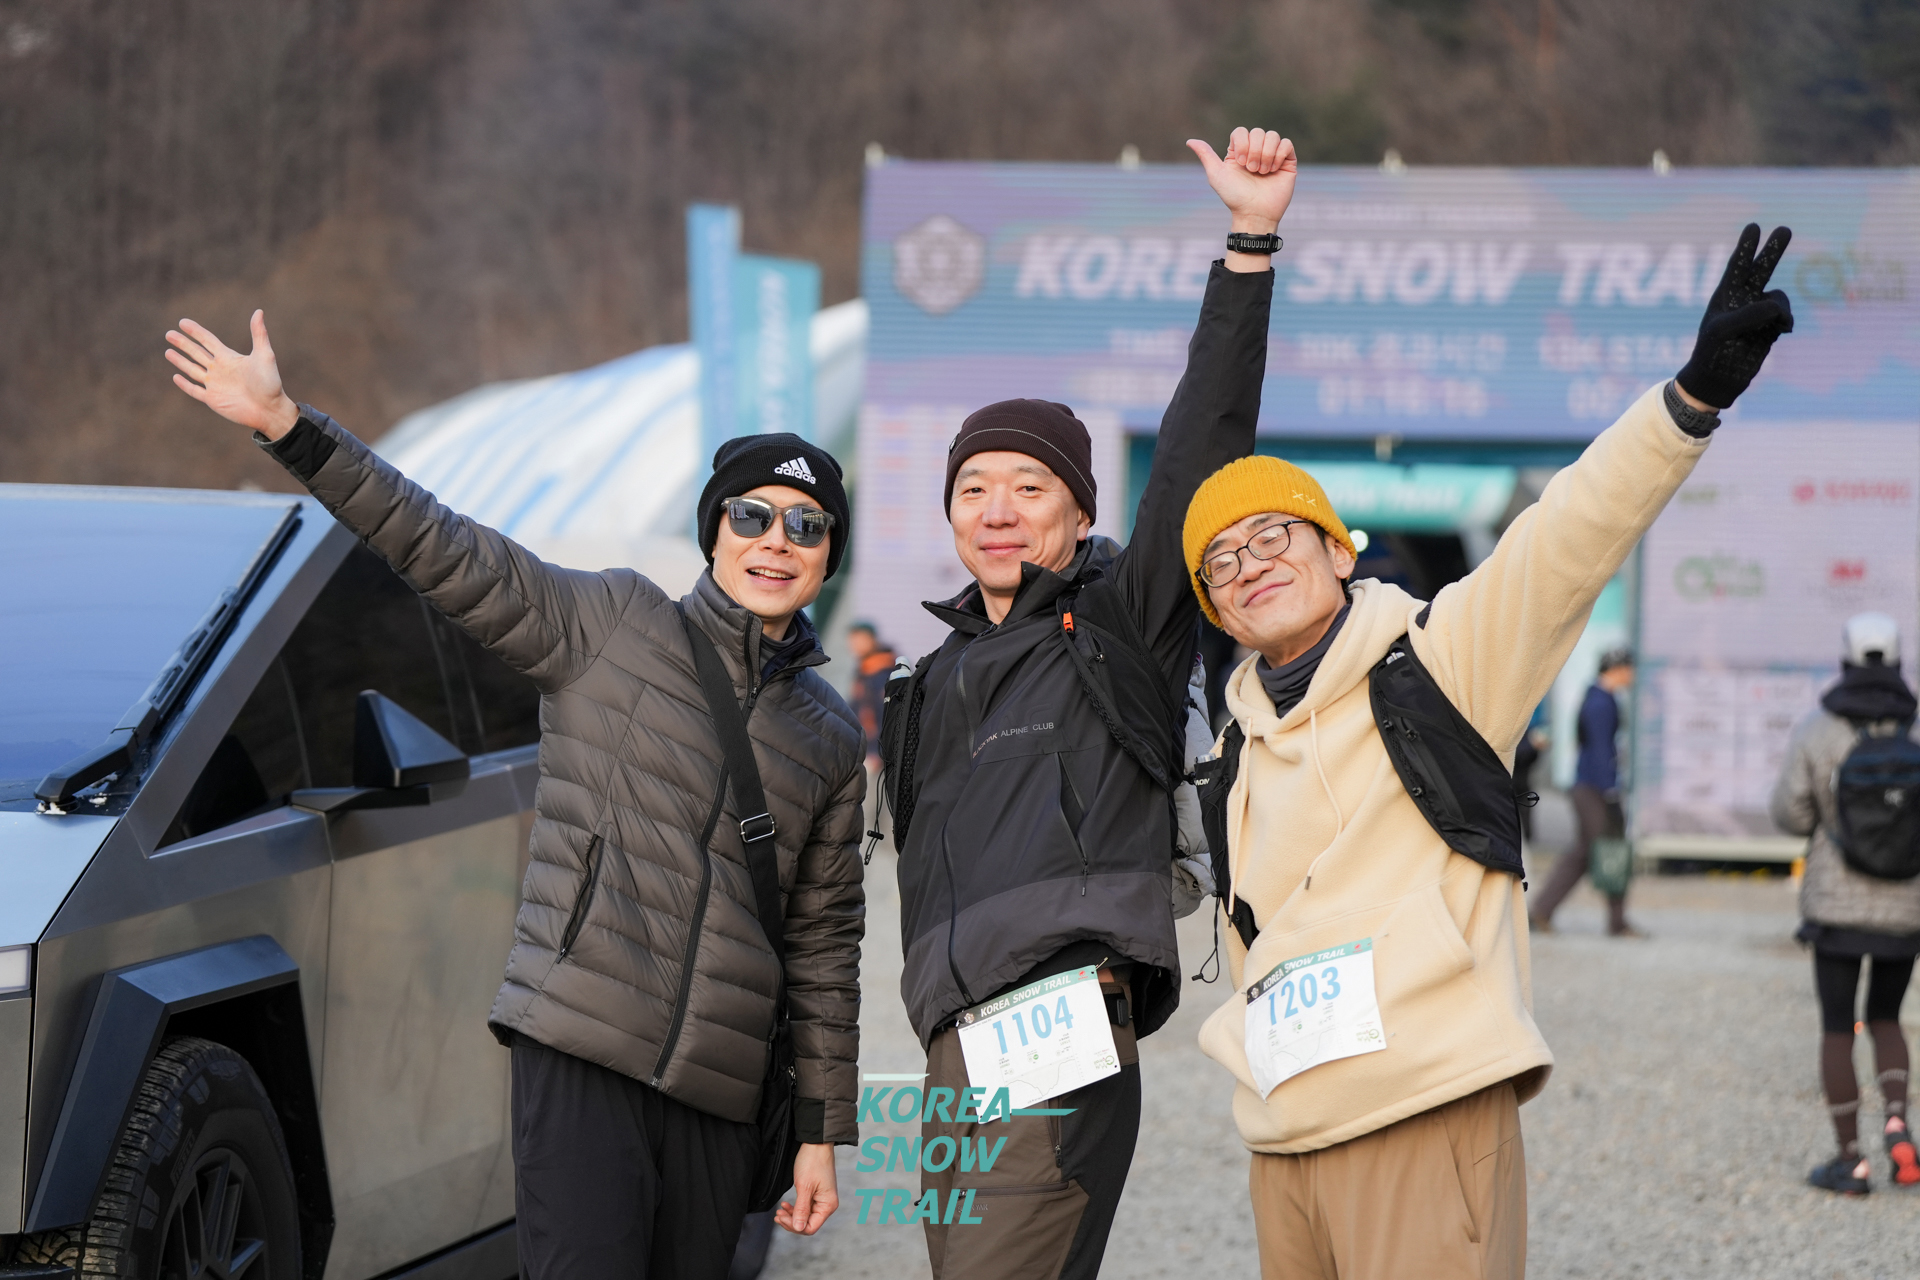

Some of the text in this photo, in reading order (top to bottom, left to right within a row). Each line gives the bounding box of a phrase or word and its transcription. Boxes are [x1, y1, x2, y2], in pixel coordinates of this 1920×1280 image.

[1017, 236, 1222, 298] KORE
[1288, 241, 1531, 304] SNOW
[1557, 243, 1727, 306] TRAI
[774, 466, 817, 485] adidas
[1000, 725, 1029, 737] ALPINE
[1032, 722, 1054, 731] CLUB
[1263, 948, 1346, 991] KOREA SNOW TRAIL
[980, 975, 1072, 1018] KOREA SNOW TRAIL
[1268, 966, 1341, 1026] 1203
[992, 995, 1074, 1055] 1104
